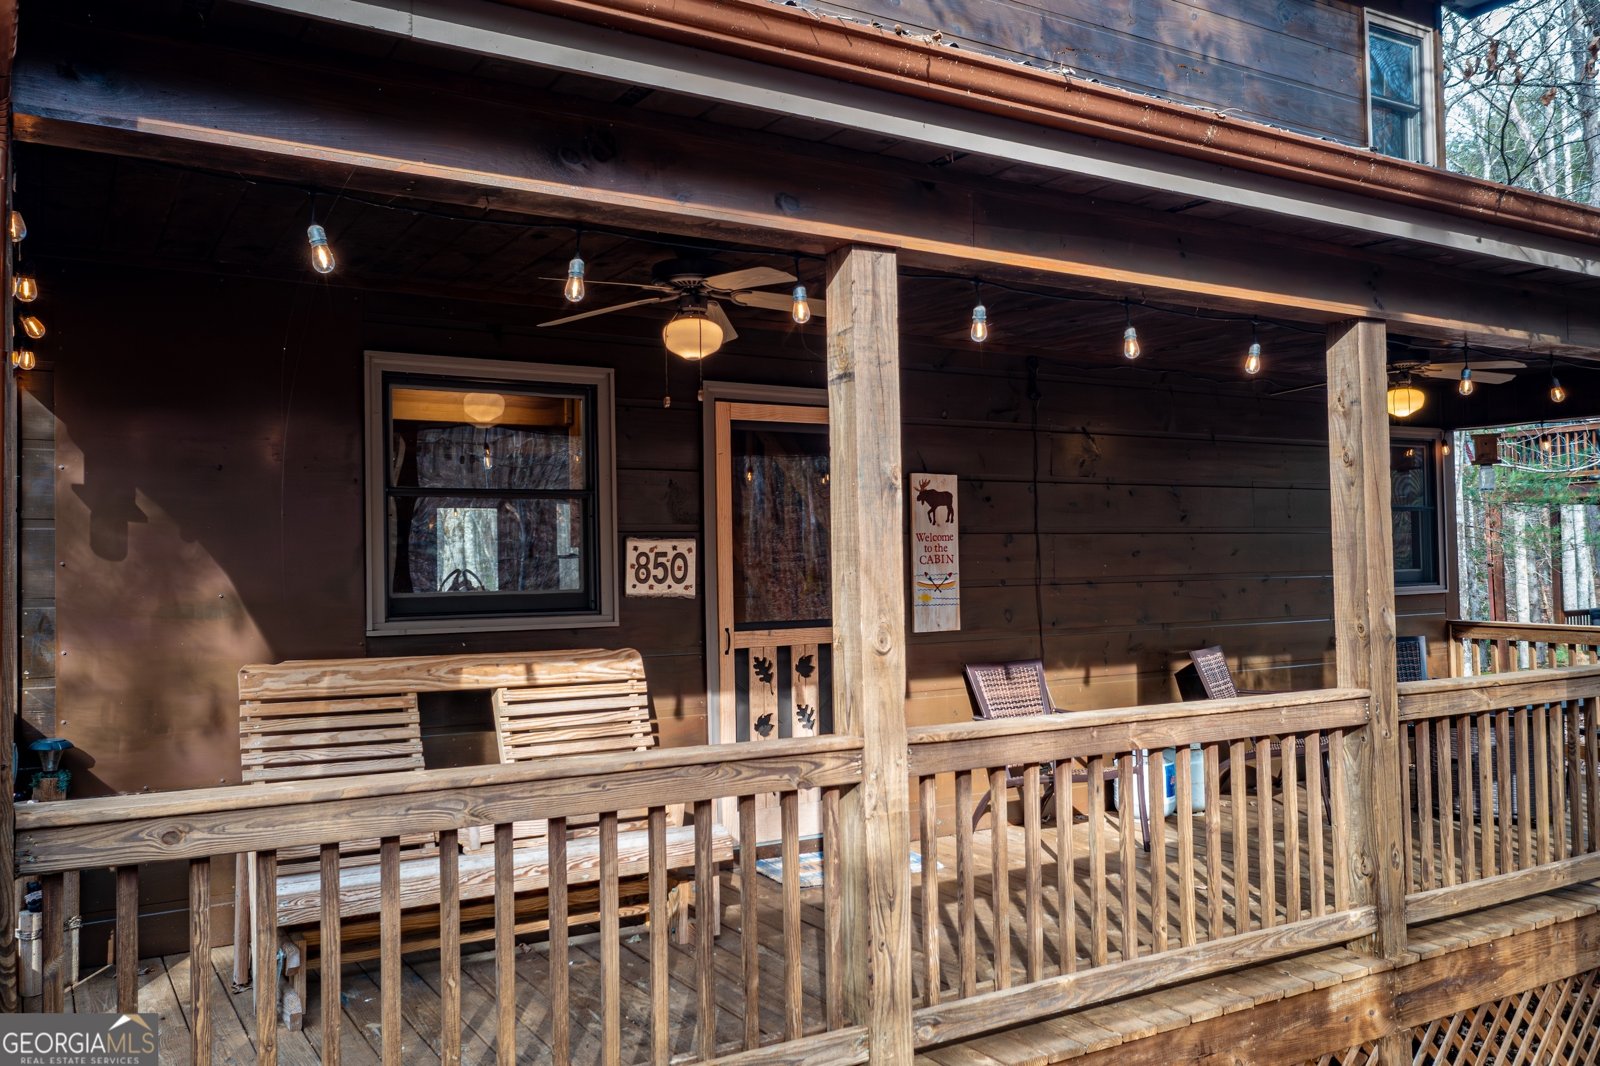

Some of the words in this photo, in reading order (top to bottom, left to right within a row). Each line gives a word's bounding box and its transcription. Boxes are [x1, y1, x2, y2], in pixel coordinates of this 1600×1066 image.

[916, 532, 954, 542] Welcome
[924, 544, 932, 552] to
[934, 543, 948, 552] the
[919, 554, 954, 565] CABIN
[634, 551, 689, 585] 850
